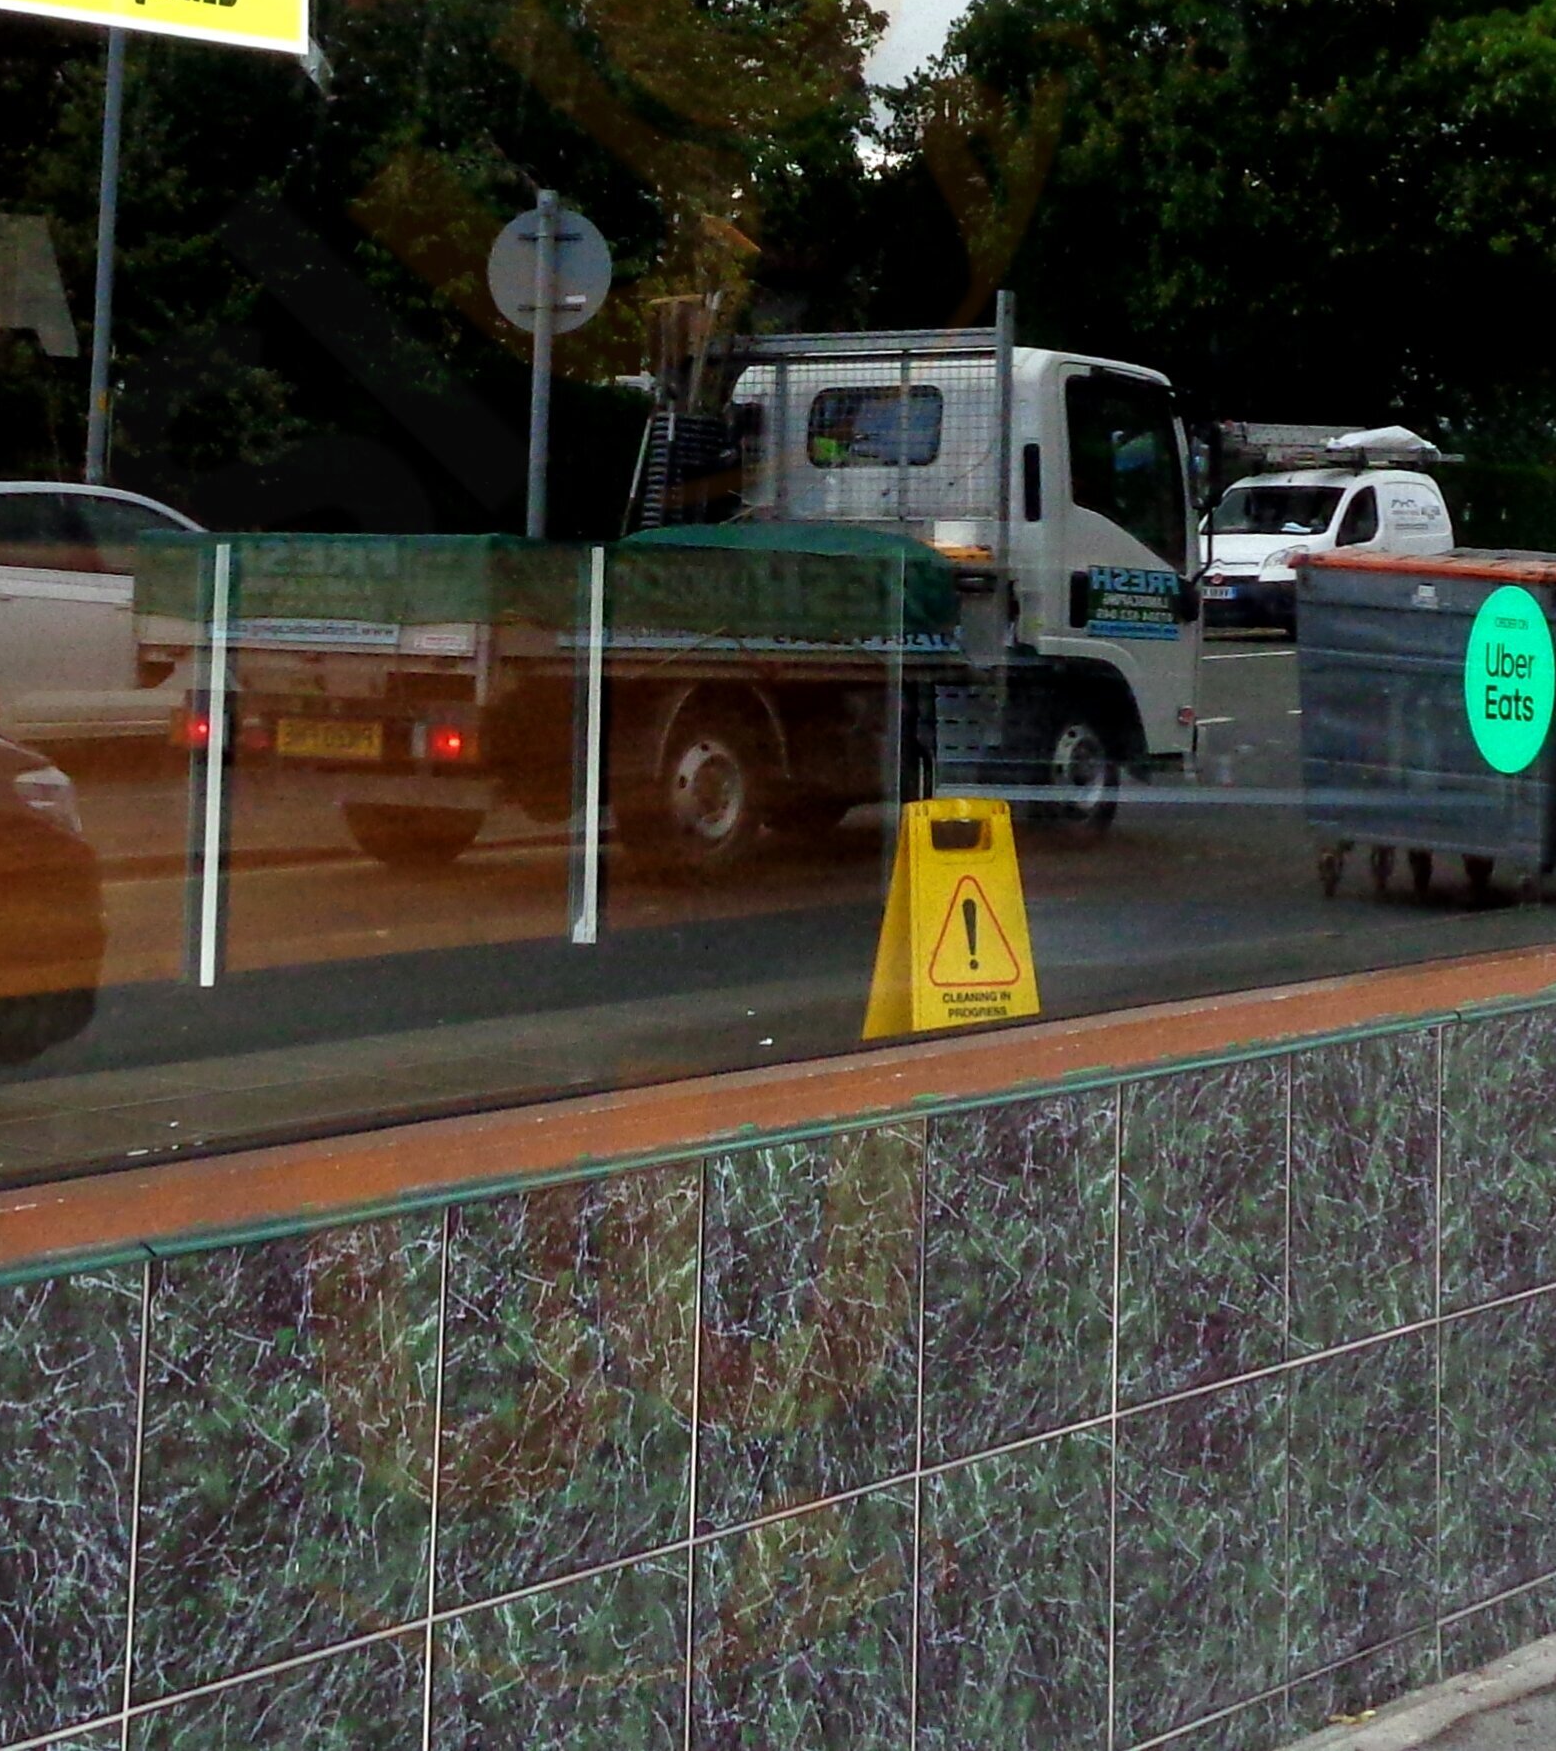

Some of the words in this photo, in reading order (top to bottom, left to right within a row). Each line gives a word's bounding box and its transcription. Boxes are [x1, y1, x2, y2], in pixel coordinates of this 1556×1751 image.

[1486, 642, 1534, 679] Uber
[1485, 685, 1534, 722] Eats
[942, 991, 997, 1004] CLEANING
[948, 1006, 1008, 1019] PROGRESS
